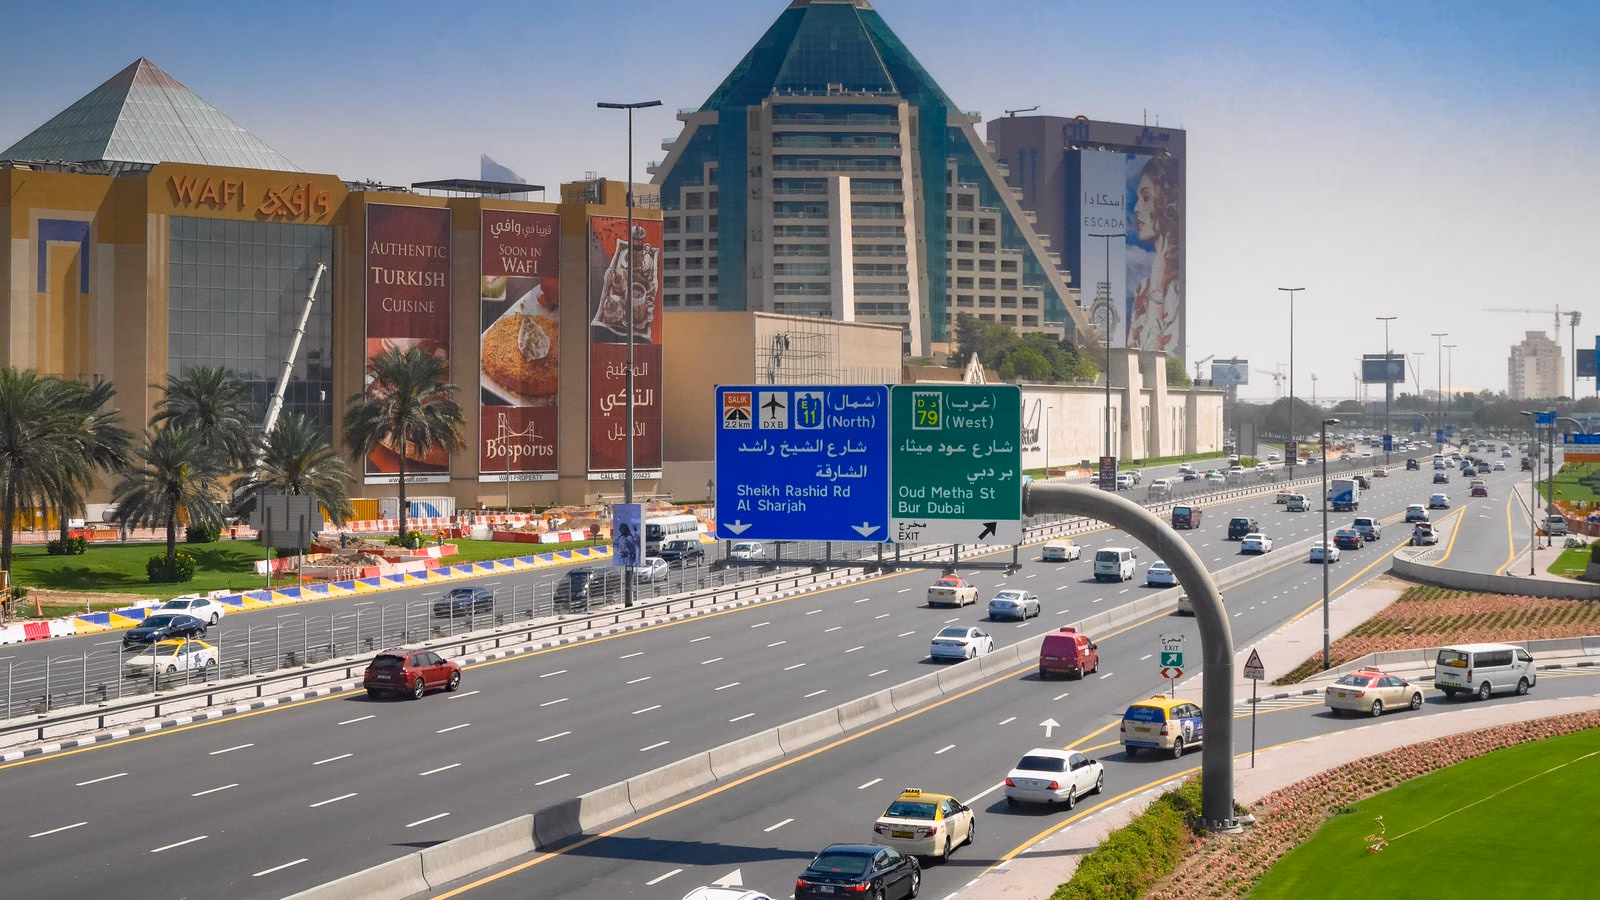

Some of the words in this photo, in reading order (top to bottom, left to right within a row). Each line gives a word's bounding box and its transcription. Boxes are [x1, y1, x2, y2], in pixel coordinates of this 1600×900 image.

[169, 175, 246, 208] WAFI
[258, 181, 331, 216] وافي
[491, 219, 521, 238] وافي
[1084, 217, 1125, 228] ESCADA
[728, 396, 747, 404] SALIK
[801, 401, 808, 409] E
[827, 391, 881, 411] (شمال)
[918, 399, 925, 408] D
[945, 393, 997, 412] (غرب)
[738, 420, 750, 428] km
[803, 411, 816, 424] 11
[827, 415, 875, 428] (North)
[917, 410, 938, 425] 79
[945, 415, 994, 429] (West)
[486, 439, 554, 463] Bosporus
[738, 438, 775, 455] راشد
[780, 439, 823, 457] الشيخ
[827, 440, 867, 457] شارع
[900, 438, 933, 455] ميثاء
[938, 443, 967, 456] عود
[972, 439, 1013, 458] شارع
[815, 464, 867, 481] الشارقة
[967, 468, 995, 484] دبي
[998, 468, 1013, 480] بر
[737, 484, 780, 497] Sheikh
[785, 485, 828, 497] Rashid
[833, 486, 851, 497] Rd
[899, 486, 925, 498] Oud
[931, 487, 973, 499] Metha
[980, 488, 996, 499] St
[737, 501, 751, 511] Al
[758, 500, 806, 513] Sharjah
[898, 501, 921, 513] Bur
[927, 502, 965, 514] Dubai
[898, 521, 927, 530] مخرج
[898, 532, 920, 541] EXIT
